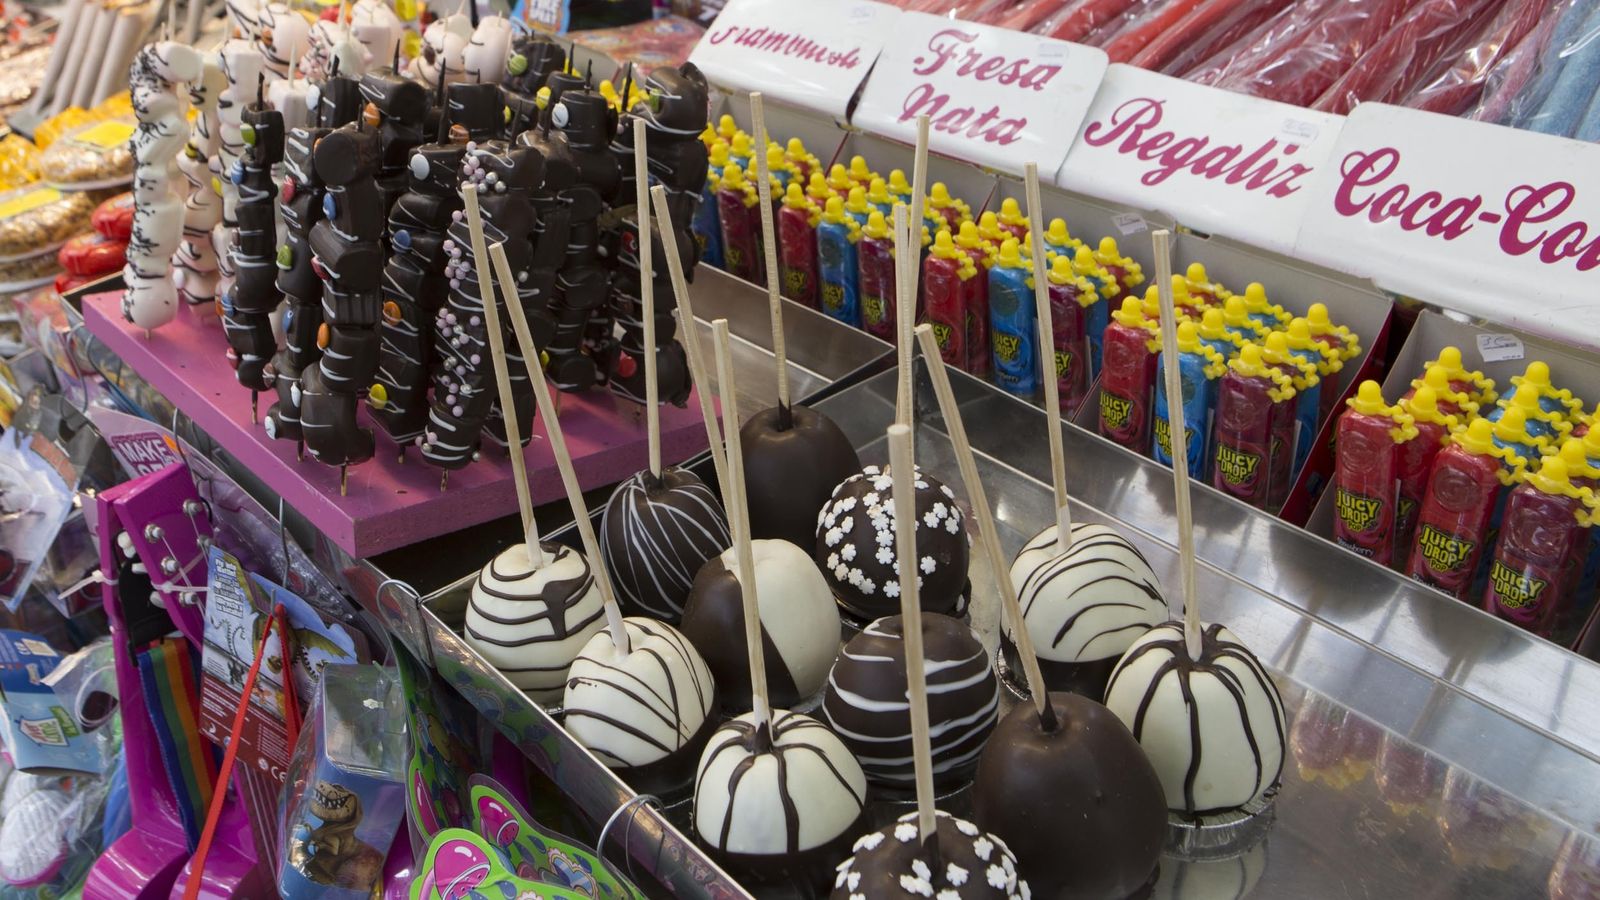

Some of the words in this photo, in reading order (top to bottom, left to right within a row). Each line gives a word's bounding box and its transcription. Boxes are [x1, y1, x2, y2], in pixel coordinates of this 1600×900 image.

[913, 29, 1062, 91] Fresa
[897, 83, 1027, 145] Nata
[1084, 98, 1314, 198] Regaliz
[1334, 147, 1600, 272] Coca-Co
[1100, 391, 1131, 417] JUICY
[117, 439, 165, 462] MAKE
[1217, 445, 1258, 473] JUICY
[1221, 459, 1248, 479] DROP
[1336, 489, 1379, 518] JUICY
[1341, 504, 1369, 525] DROP
[1420, 526, 1473, 560] JUICY
[1423, 542, 1458, 567] DROP
[1430, 559, 1449, 572] POP
[1491, 561, 1544, 598] JUICY
[1495, 577, 1529, 604] DROP
[1501, 596, 1520, 608] POP
